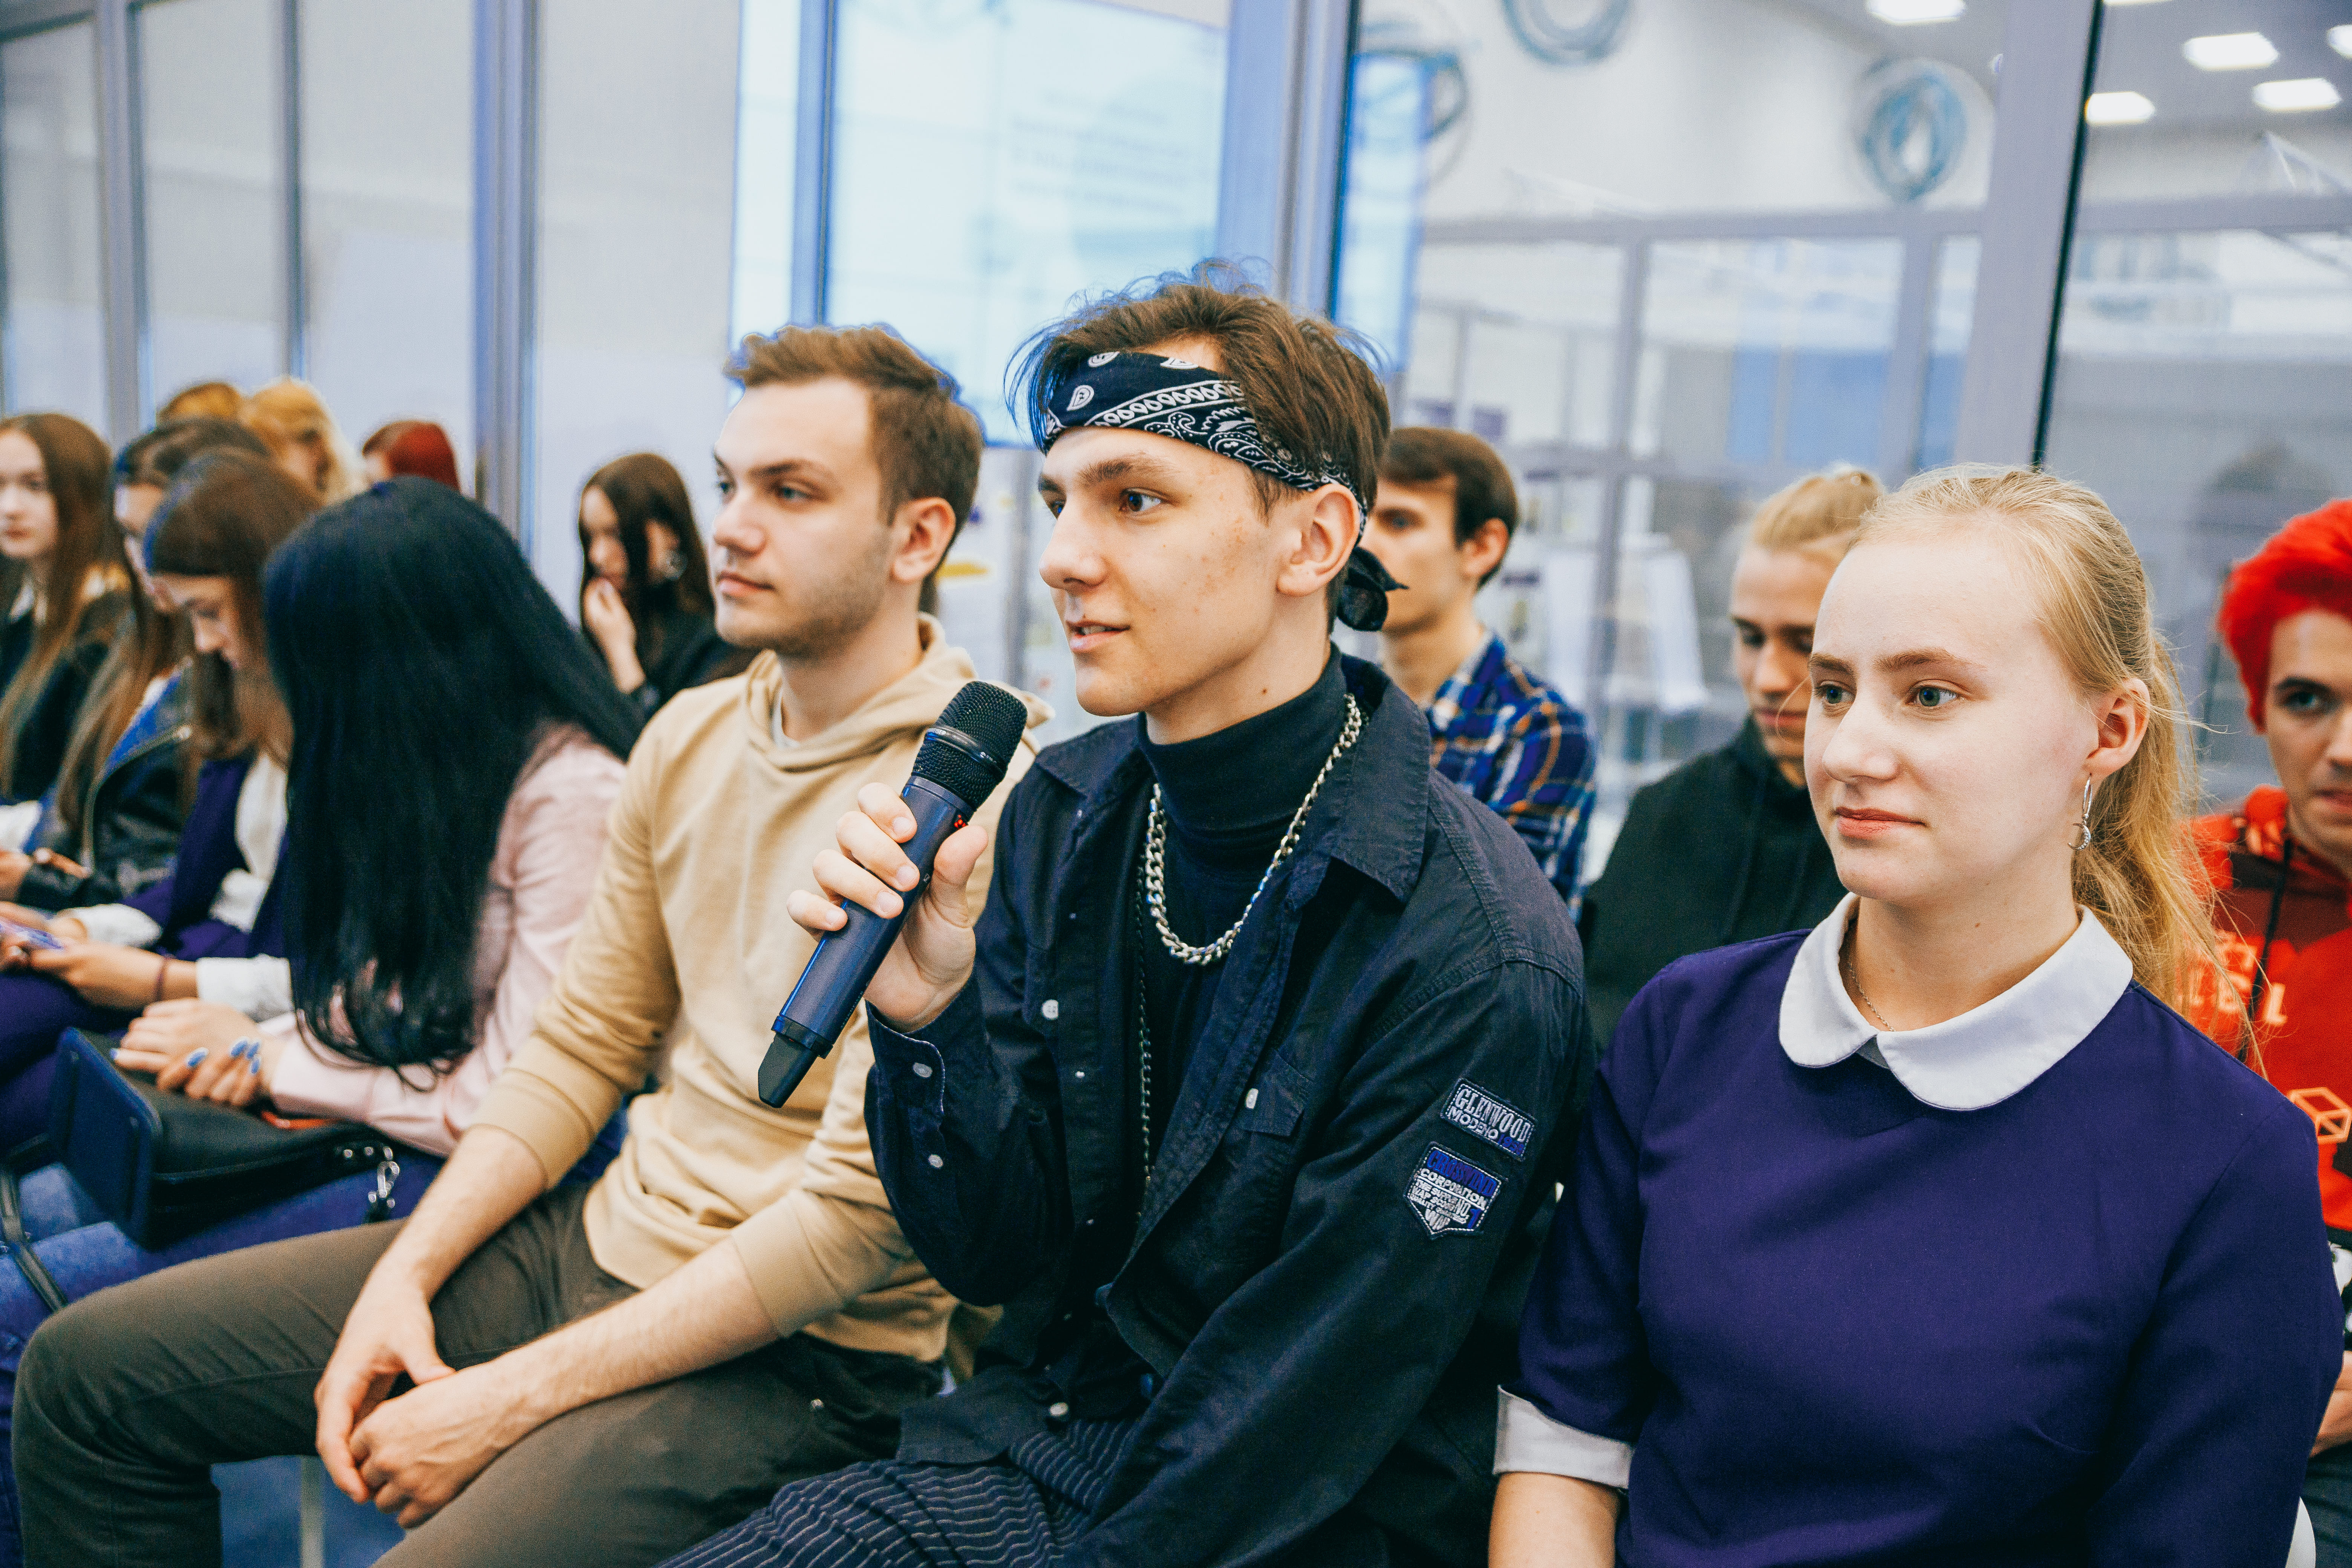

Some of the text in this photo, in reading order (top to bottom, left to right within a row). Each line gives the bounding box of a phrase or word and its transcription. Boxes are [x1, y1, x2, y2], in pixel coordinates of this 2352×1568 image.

[1455, 1089, 1531, 1142] GLENWOOD
[1415, 1179, 1433, 1191] THE
[1420, 1168, 1487, 1207] CORPORATION
[1427, 1150, 1497, 1196] CROSSWIND
[1410, 1193, 1436, 1210] QUALITY
[1467, 1208, 1482, 1229] 1
